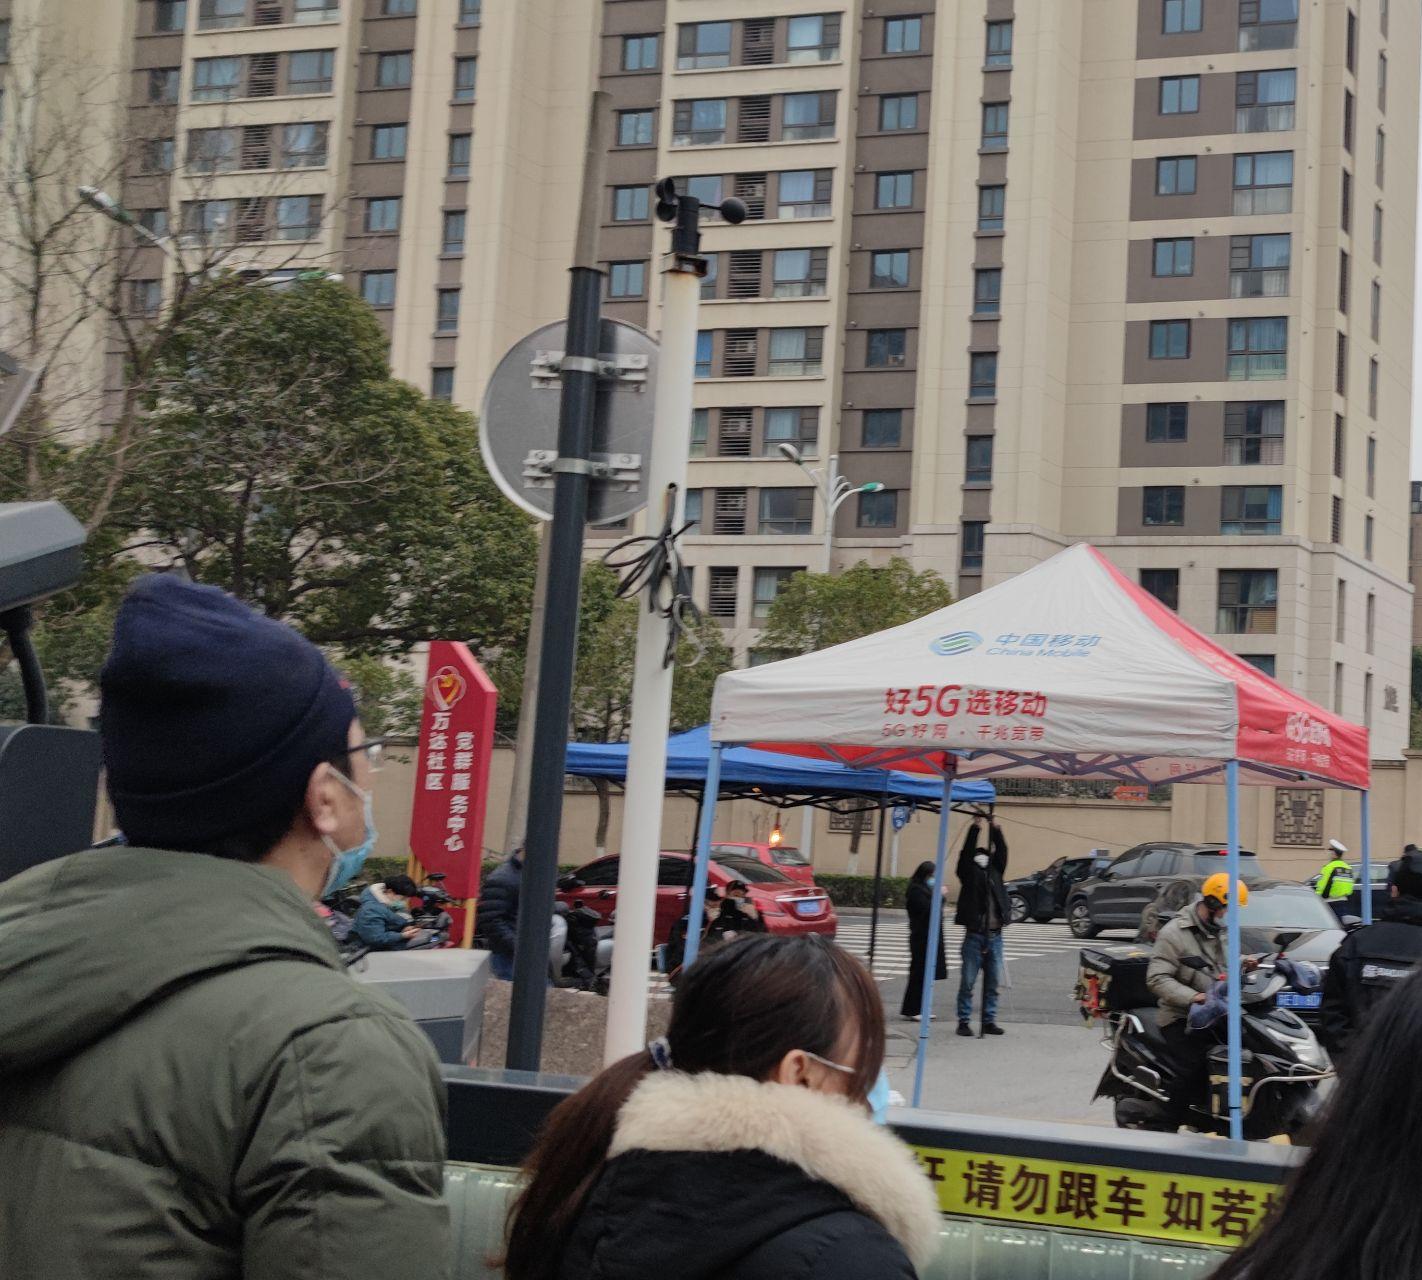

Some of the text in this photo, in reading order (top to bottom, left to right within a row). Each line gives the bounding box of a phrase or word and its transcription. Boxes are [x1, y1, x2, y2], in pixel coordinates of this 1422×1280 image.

[986, 647, 1091, 658] China Mobile
[995, 632, 1102, 647] 中国移动
[884, 684, 1049, 718] 好5G选移动
[424, 711, 452, 791] 万达社区
[443, 731, 475, 852] 党群服务中心
[963, 1159, 1147, 1227] 请勿跟车
